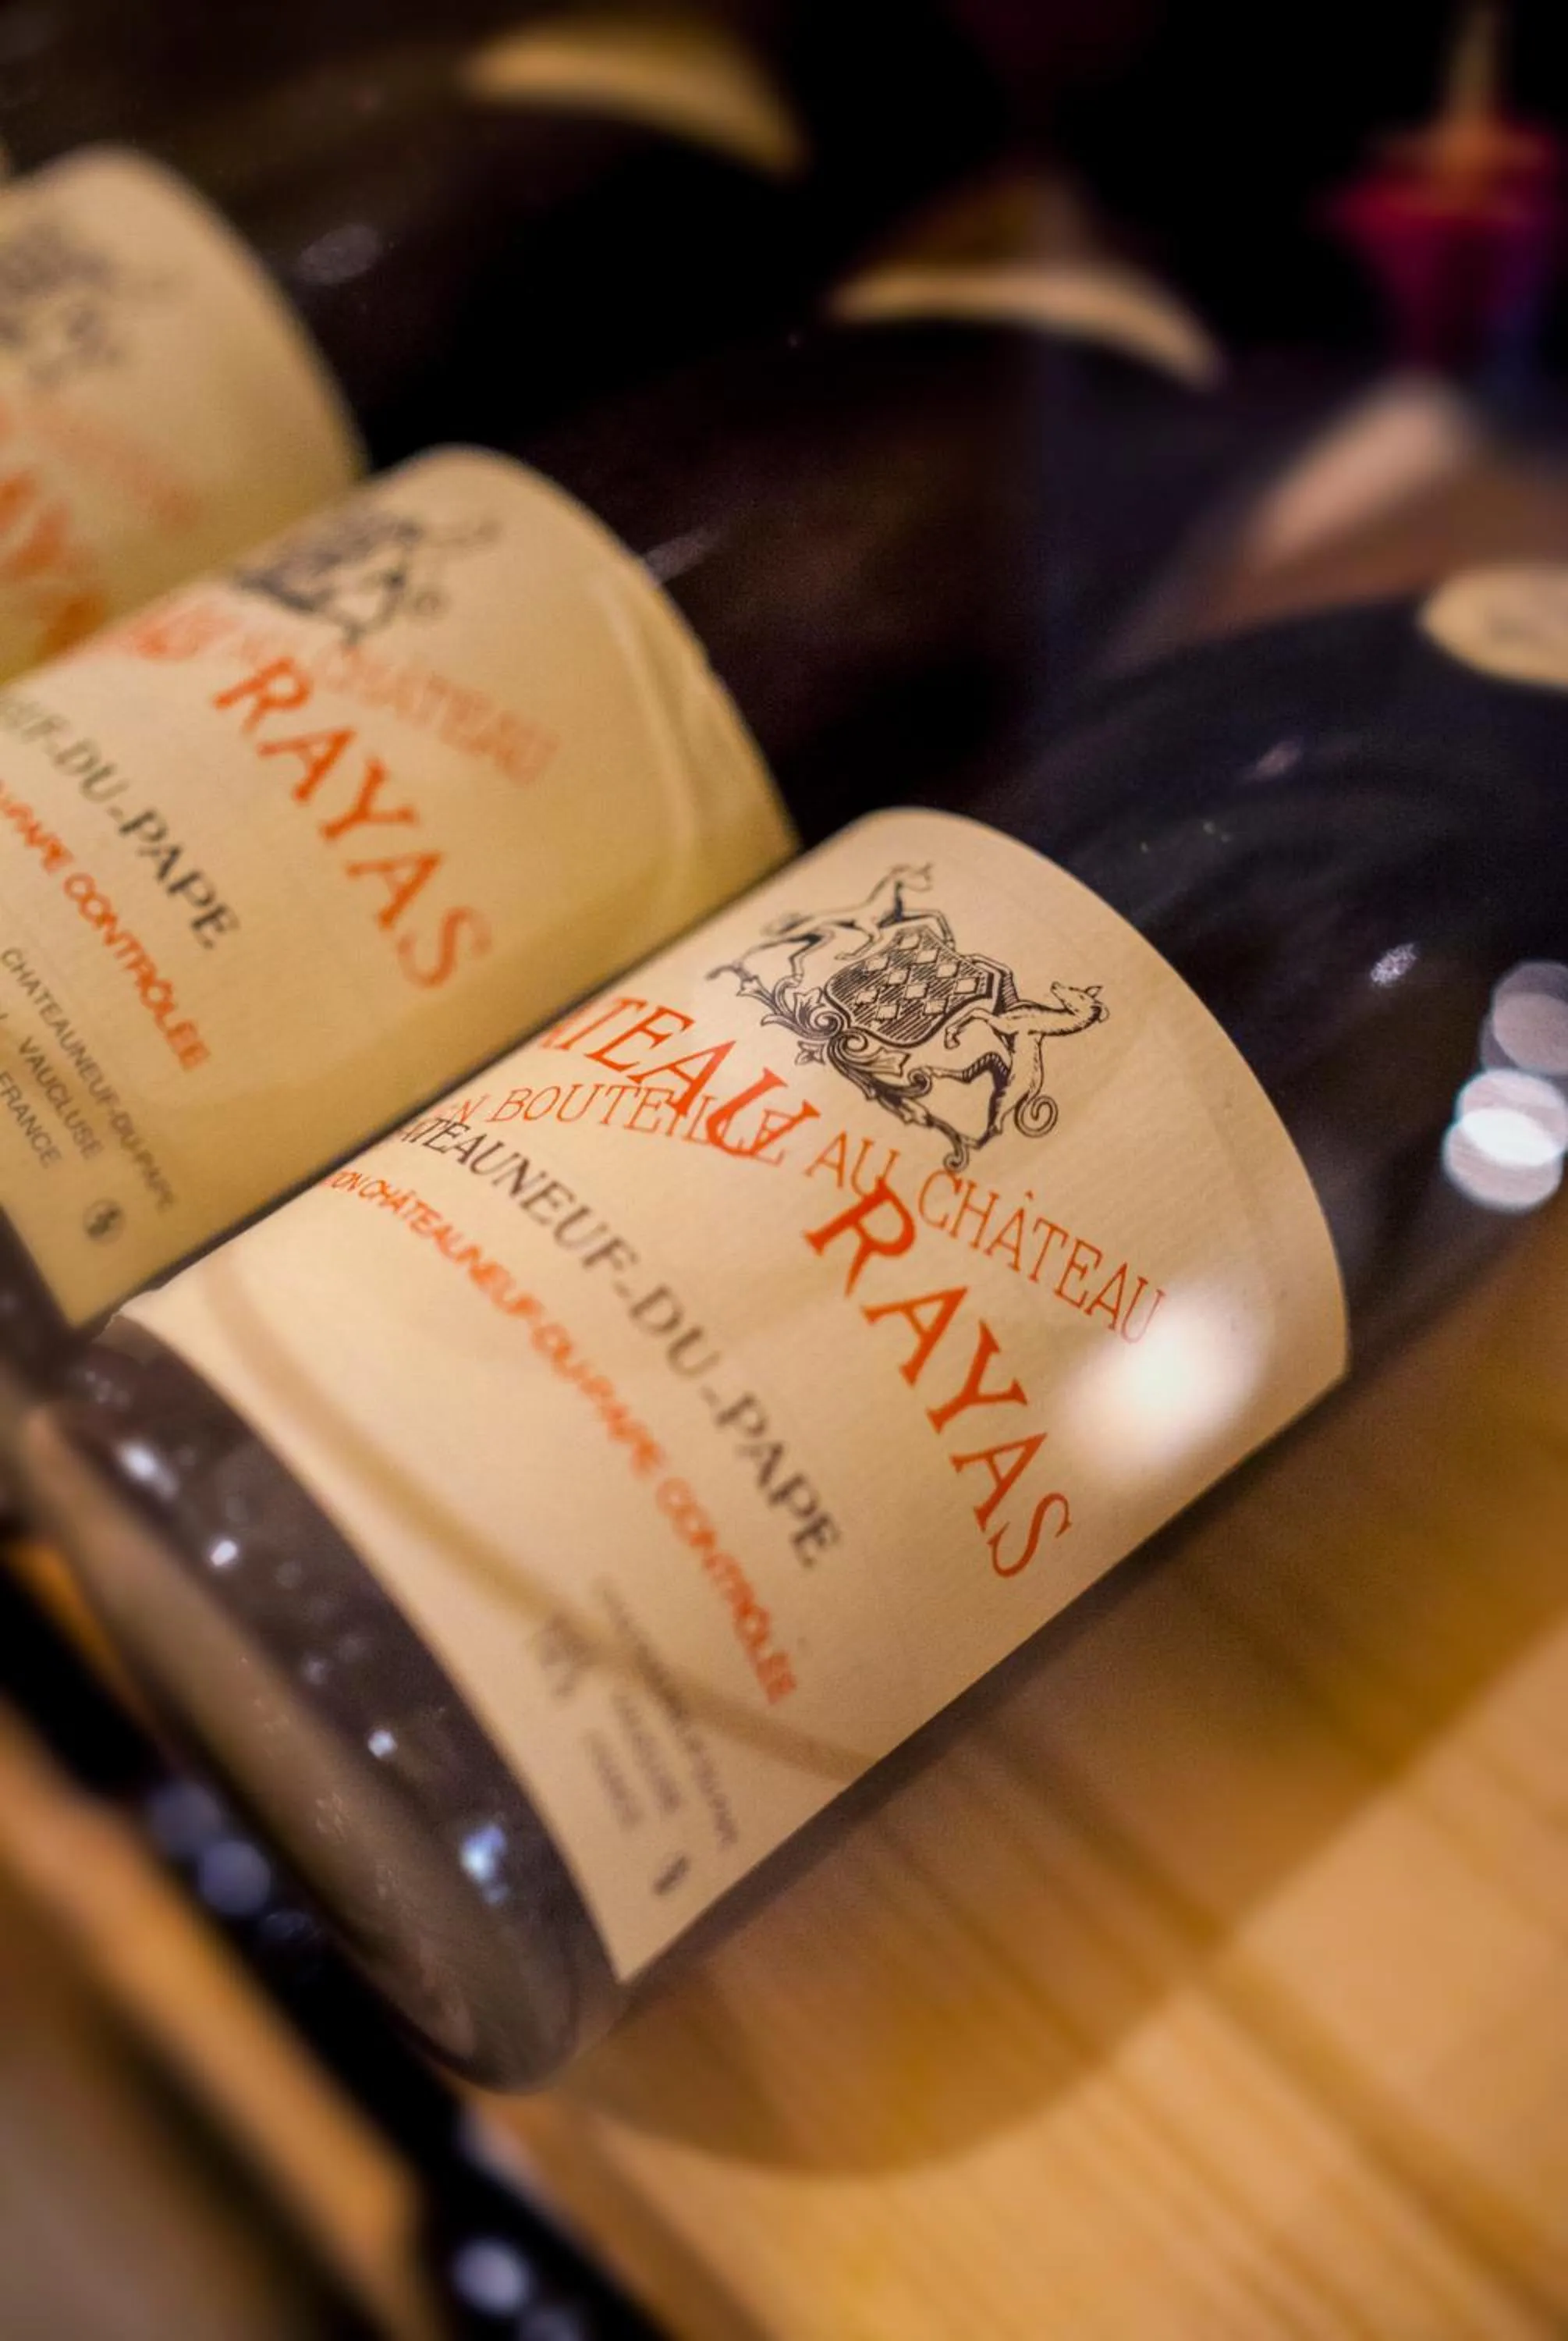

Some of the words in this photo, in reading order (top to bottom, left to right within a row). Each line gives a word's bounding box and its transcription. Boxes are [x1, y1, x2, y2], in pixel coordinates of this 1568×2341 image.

[212, 655, 491, 991] RAYAS
[0, 1071, 62, 1169] FRANCE
[19, 1035, 104, 1161] VAUCLUSE
[485, 1083, 788, 1167] BOUTEILLE
[804, 1130, 901, 1204] AU
[802, 1177, 1072, 1578] RAYAS
